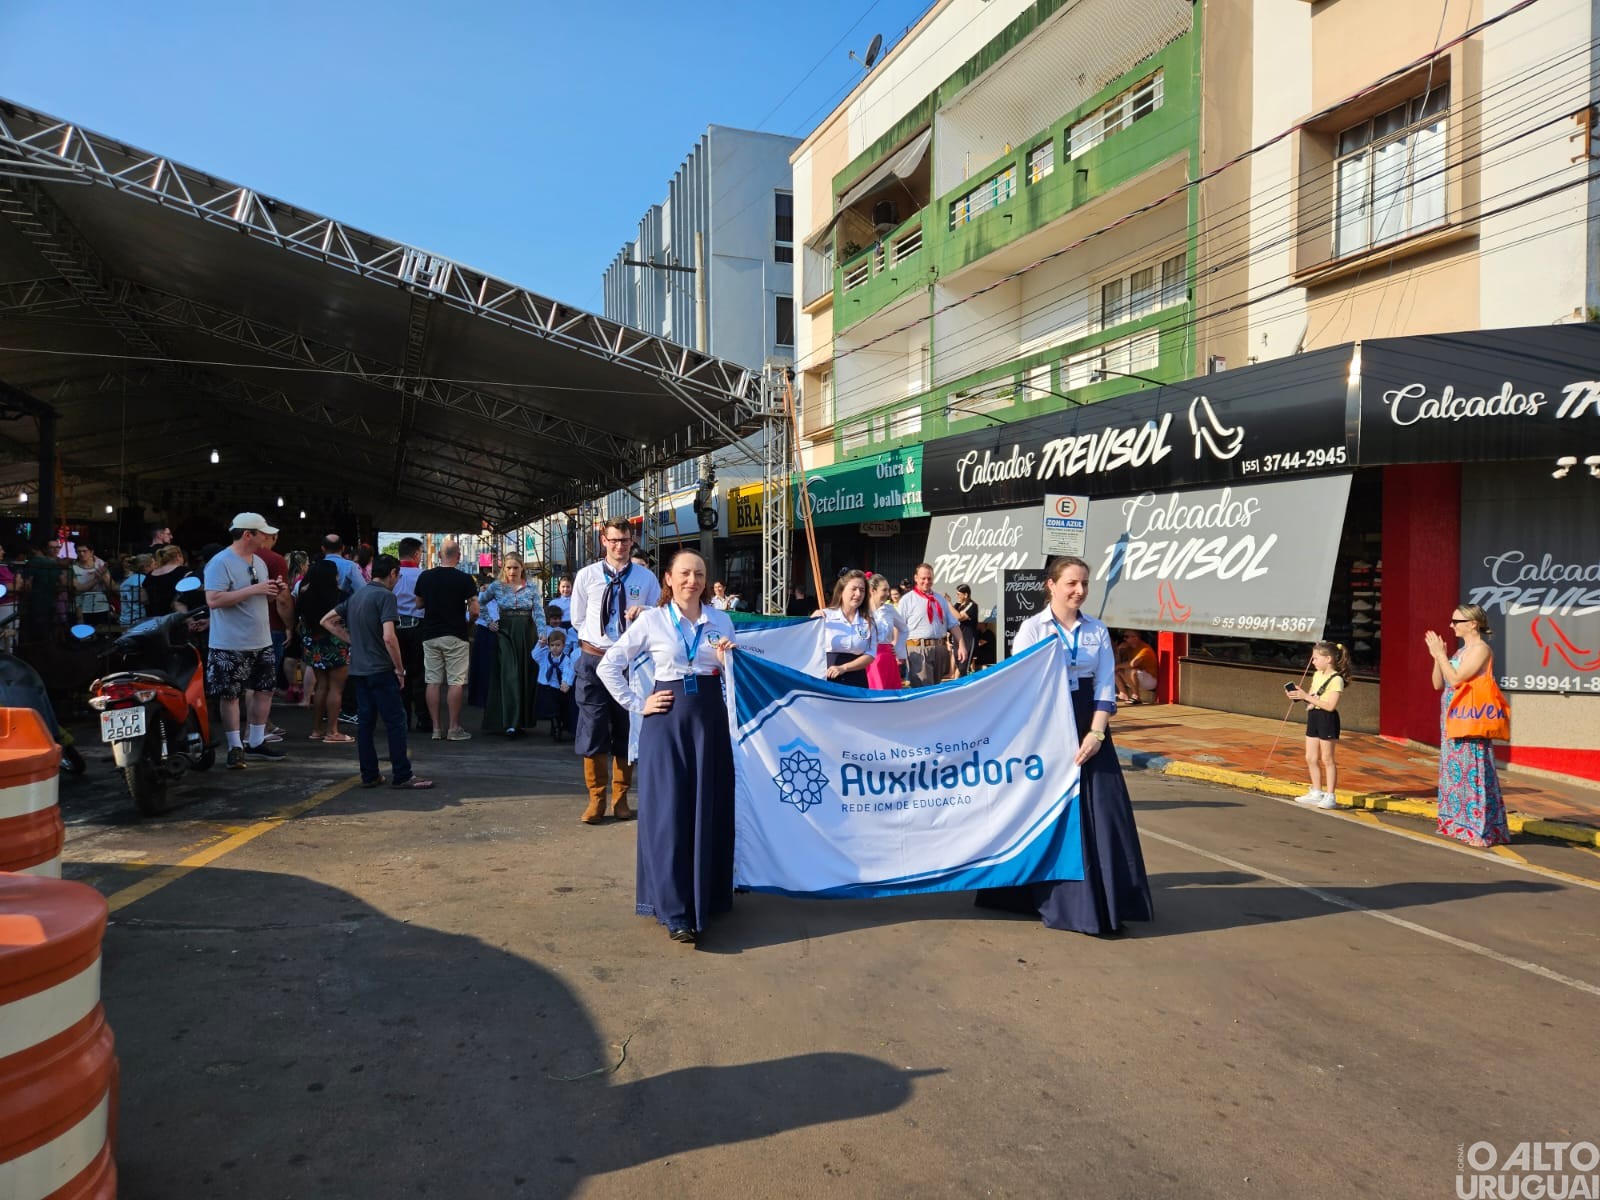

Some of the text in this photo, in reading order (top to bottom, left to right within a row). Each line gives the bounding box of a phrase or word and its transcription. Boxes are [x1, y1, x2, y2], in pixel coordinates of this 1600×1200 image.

[1383, 381, 1548, 426] Calçados
[957, 412, 1173, 493] Calçados TREVISOL
[1262, 446, 1347, 473] 3744-2945
[876, 456, 915, 480] Ótica &
[873, 484, 922, 509] Joalheria
[1061, 501, 1071, 513] E
[1067, 520, 1082, 528] AZUL
[1122, 487, 1262, 540] Calçados
[947, 515, 1024, 553] Calçados
[1096, 533, 1278, 583] TREVISOL
[1005, 582, 1045, 592] TREVISOL
[1222, 616, 1317, 633] 55 99941-8367
[1500, 676, 1518, 688] 55
[107, 724, 140, 739] 2504
[110, 714, 139, 728] IYP
[842, 736, 990, 762] Escola Nossa Senhora
[840, 751, 1044, 797] Auxiliadora
[841, 794, 971, 813] REDE ICM DE EDUCAÇÃO
